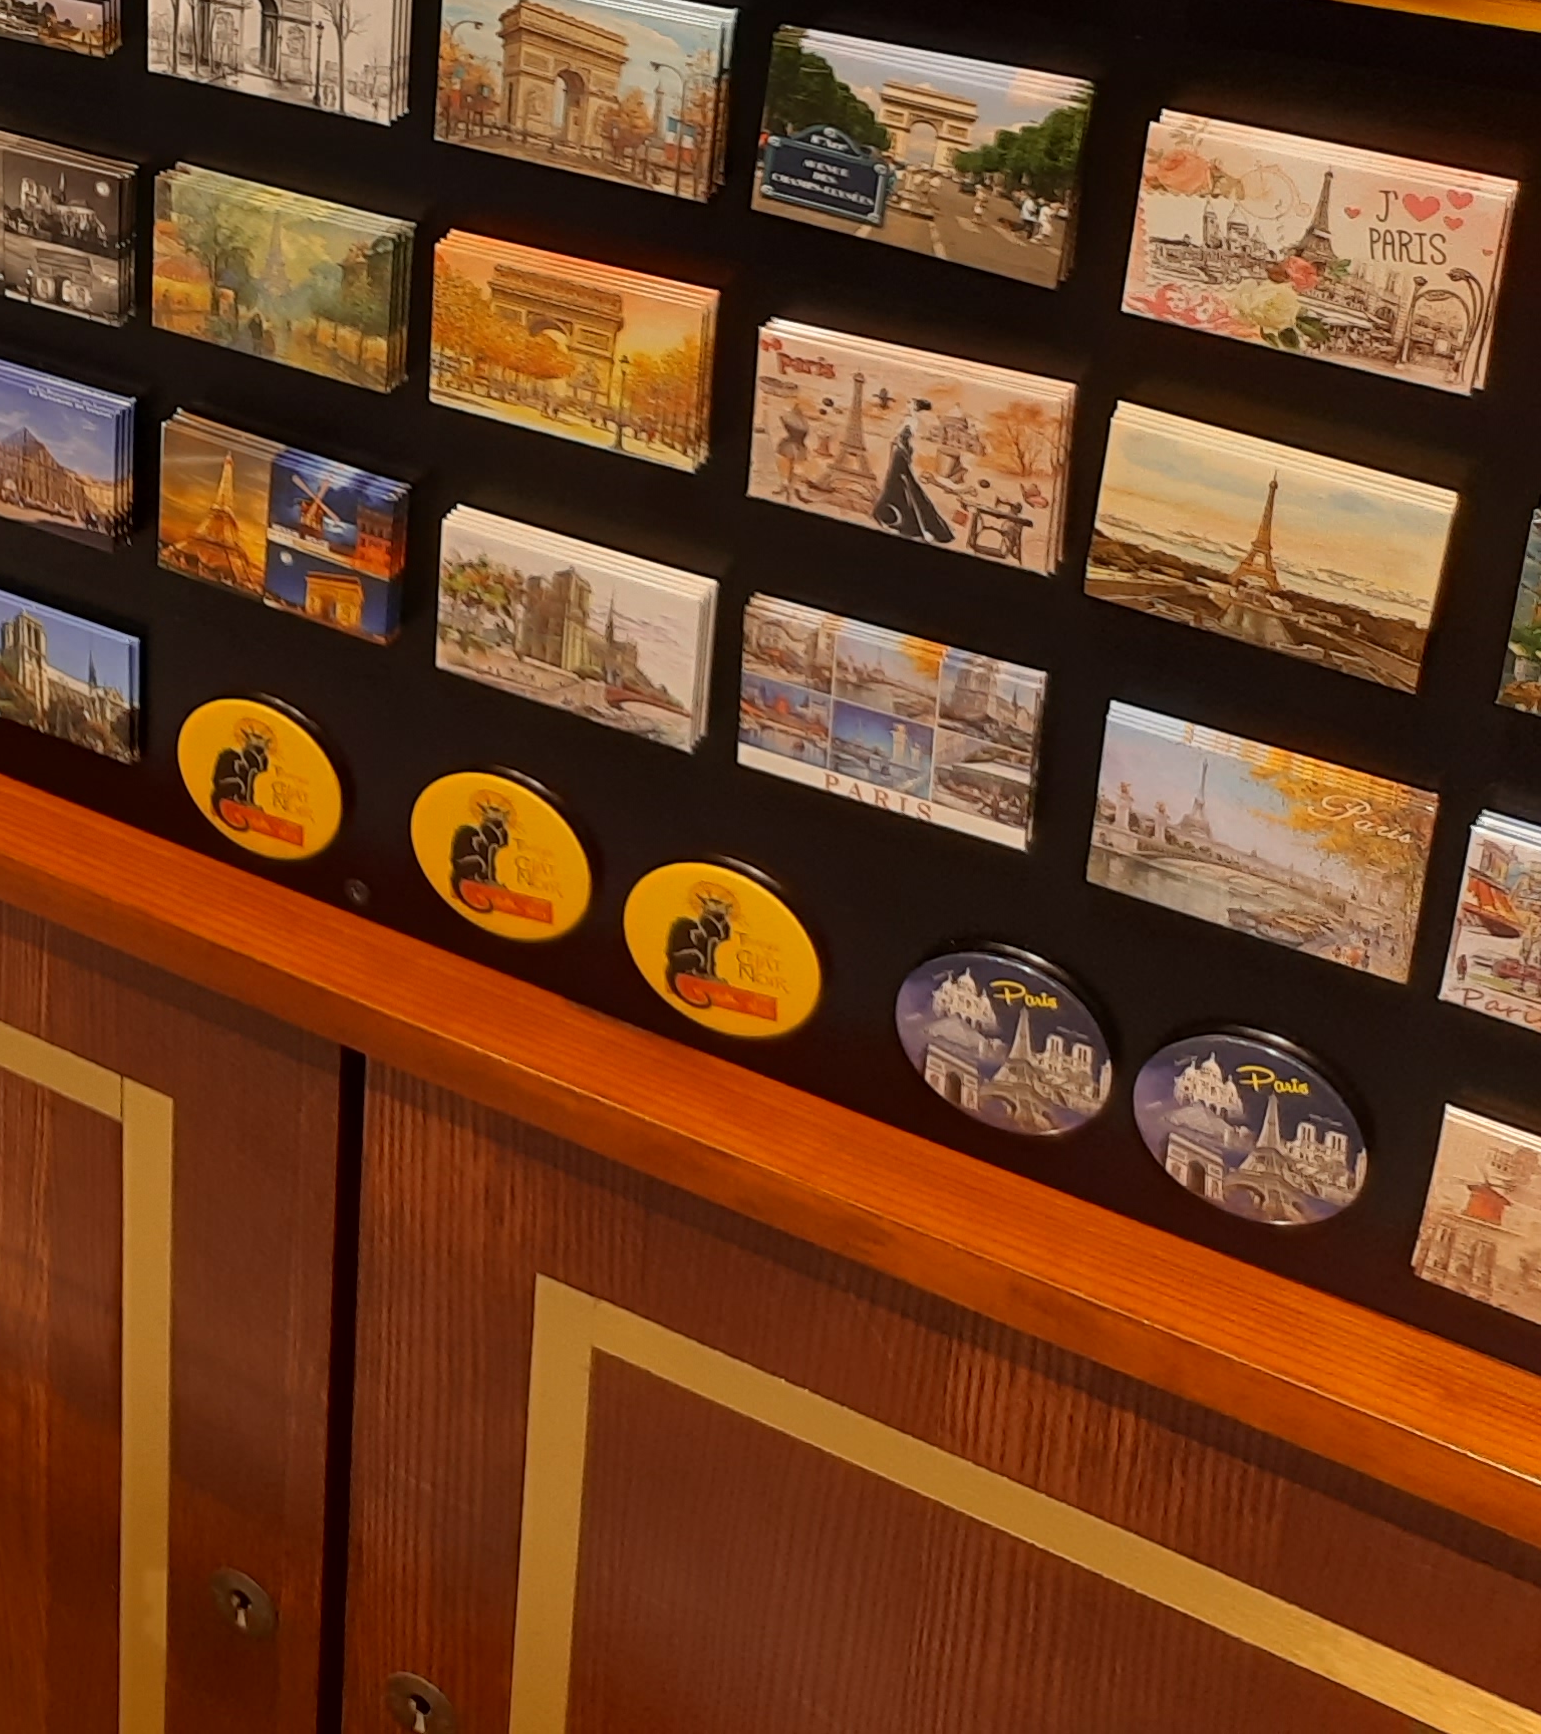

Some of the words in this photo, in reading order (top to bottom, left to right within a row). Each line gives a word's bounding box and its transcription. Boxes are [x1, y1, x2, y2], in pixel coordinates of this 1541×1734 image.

[1368, 227, 1447, 266] PARIS
[823, 774, 932, 822] PARIS
[1306, 794, 1414, 845] Paris
[990, 979, 1058, 1009] Paris
[1463, 988, 1541, 1024] Pari
[1236, 1065, 1309, 1096] Paris
